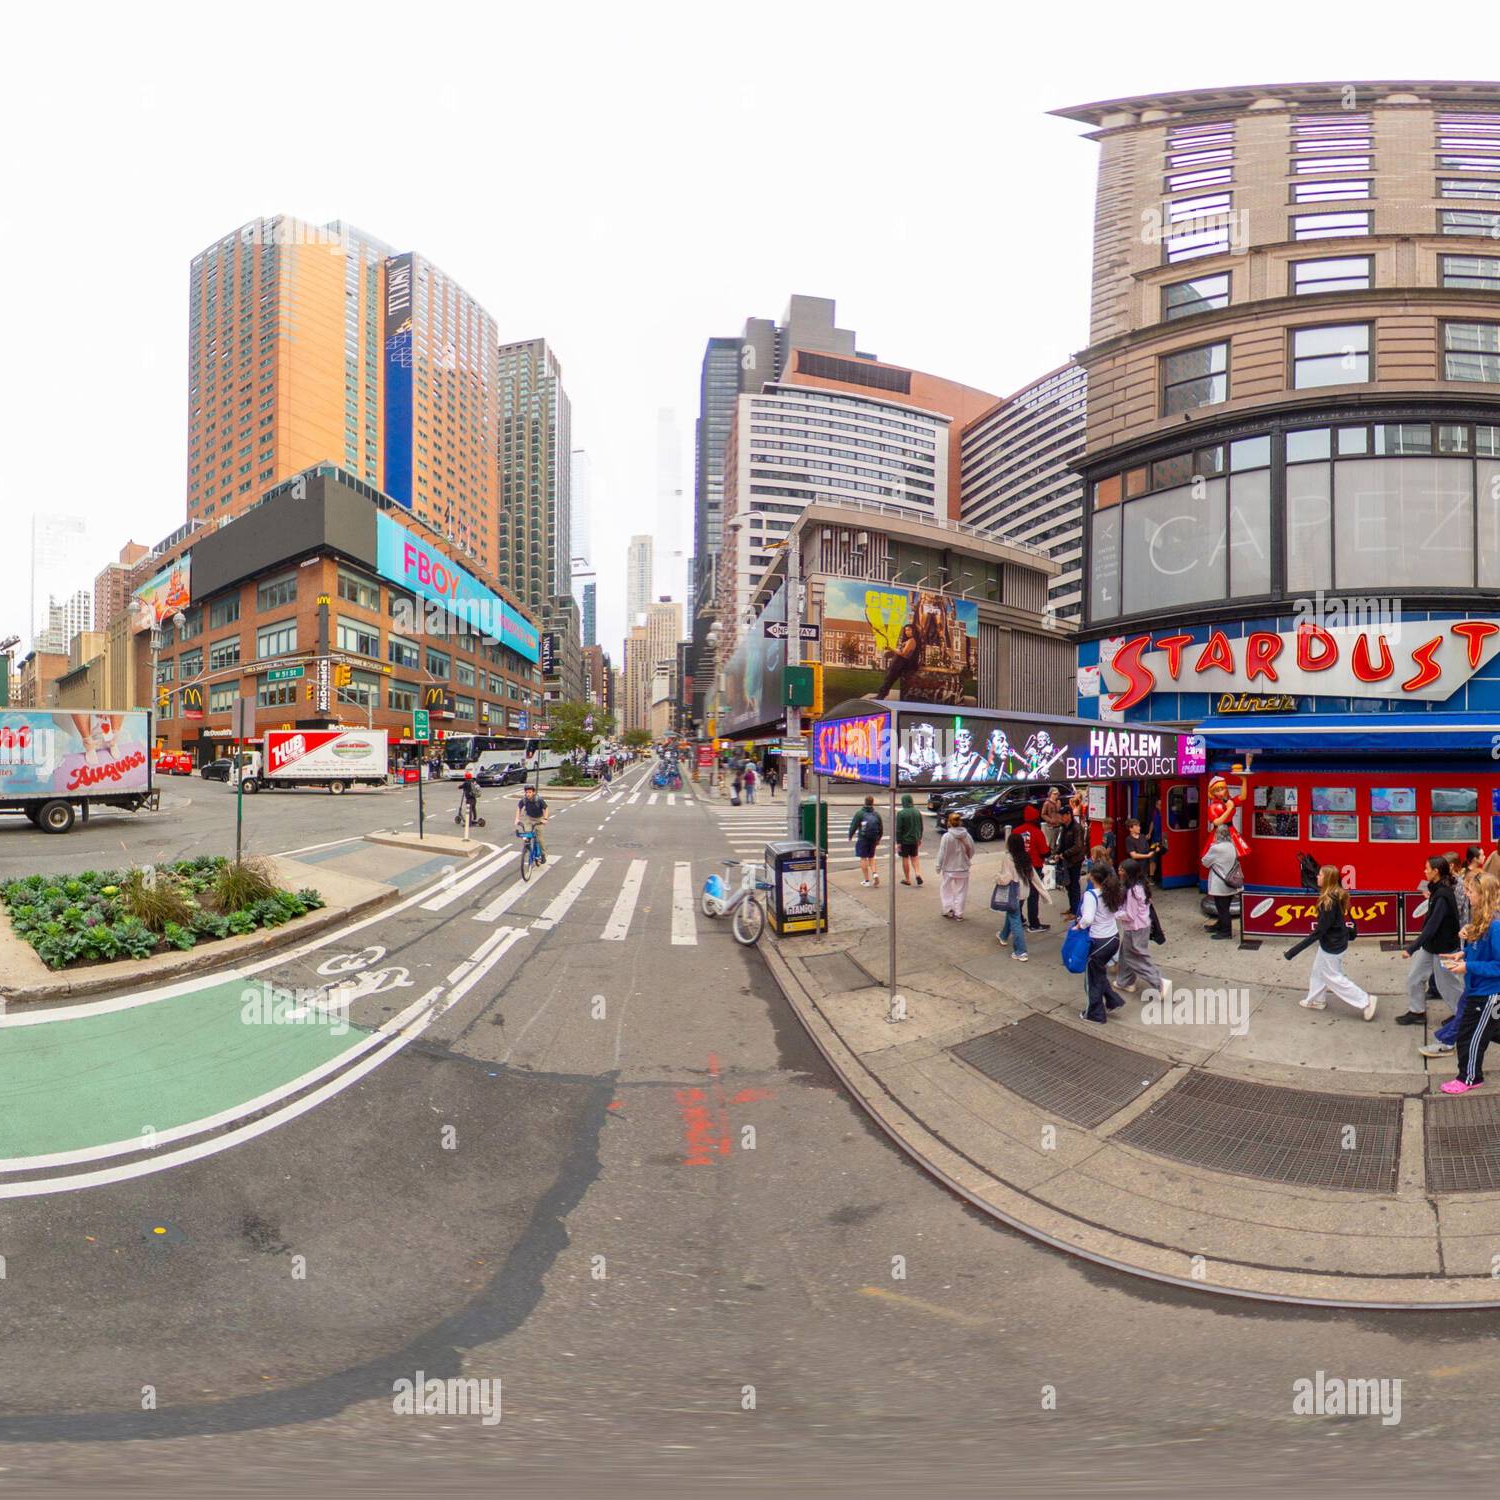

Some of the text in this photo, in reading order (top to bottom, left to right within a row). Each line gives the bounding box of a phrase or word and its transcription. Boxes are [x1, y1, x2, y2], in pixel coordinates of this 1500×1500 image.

[404, 542, 460, 600] FBOY
[865, 590, 907, 610] GEN
[275, 671, 282, 679] W
[1111, 620, 1499, 712] STARDUST
[319, 660, 328, 711] McDonald's
[1216, 692, 1299, 713] Diner
[271, 733, 304, 766] HUB
[1090, 729, 1161, 757] HARLEM
[67, 751, 146, 791] August
[1066, 757, 1176, 779] BLUES PROJECT
